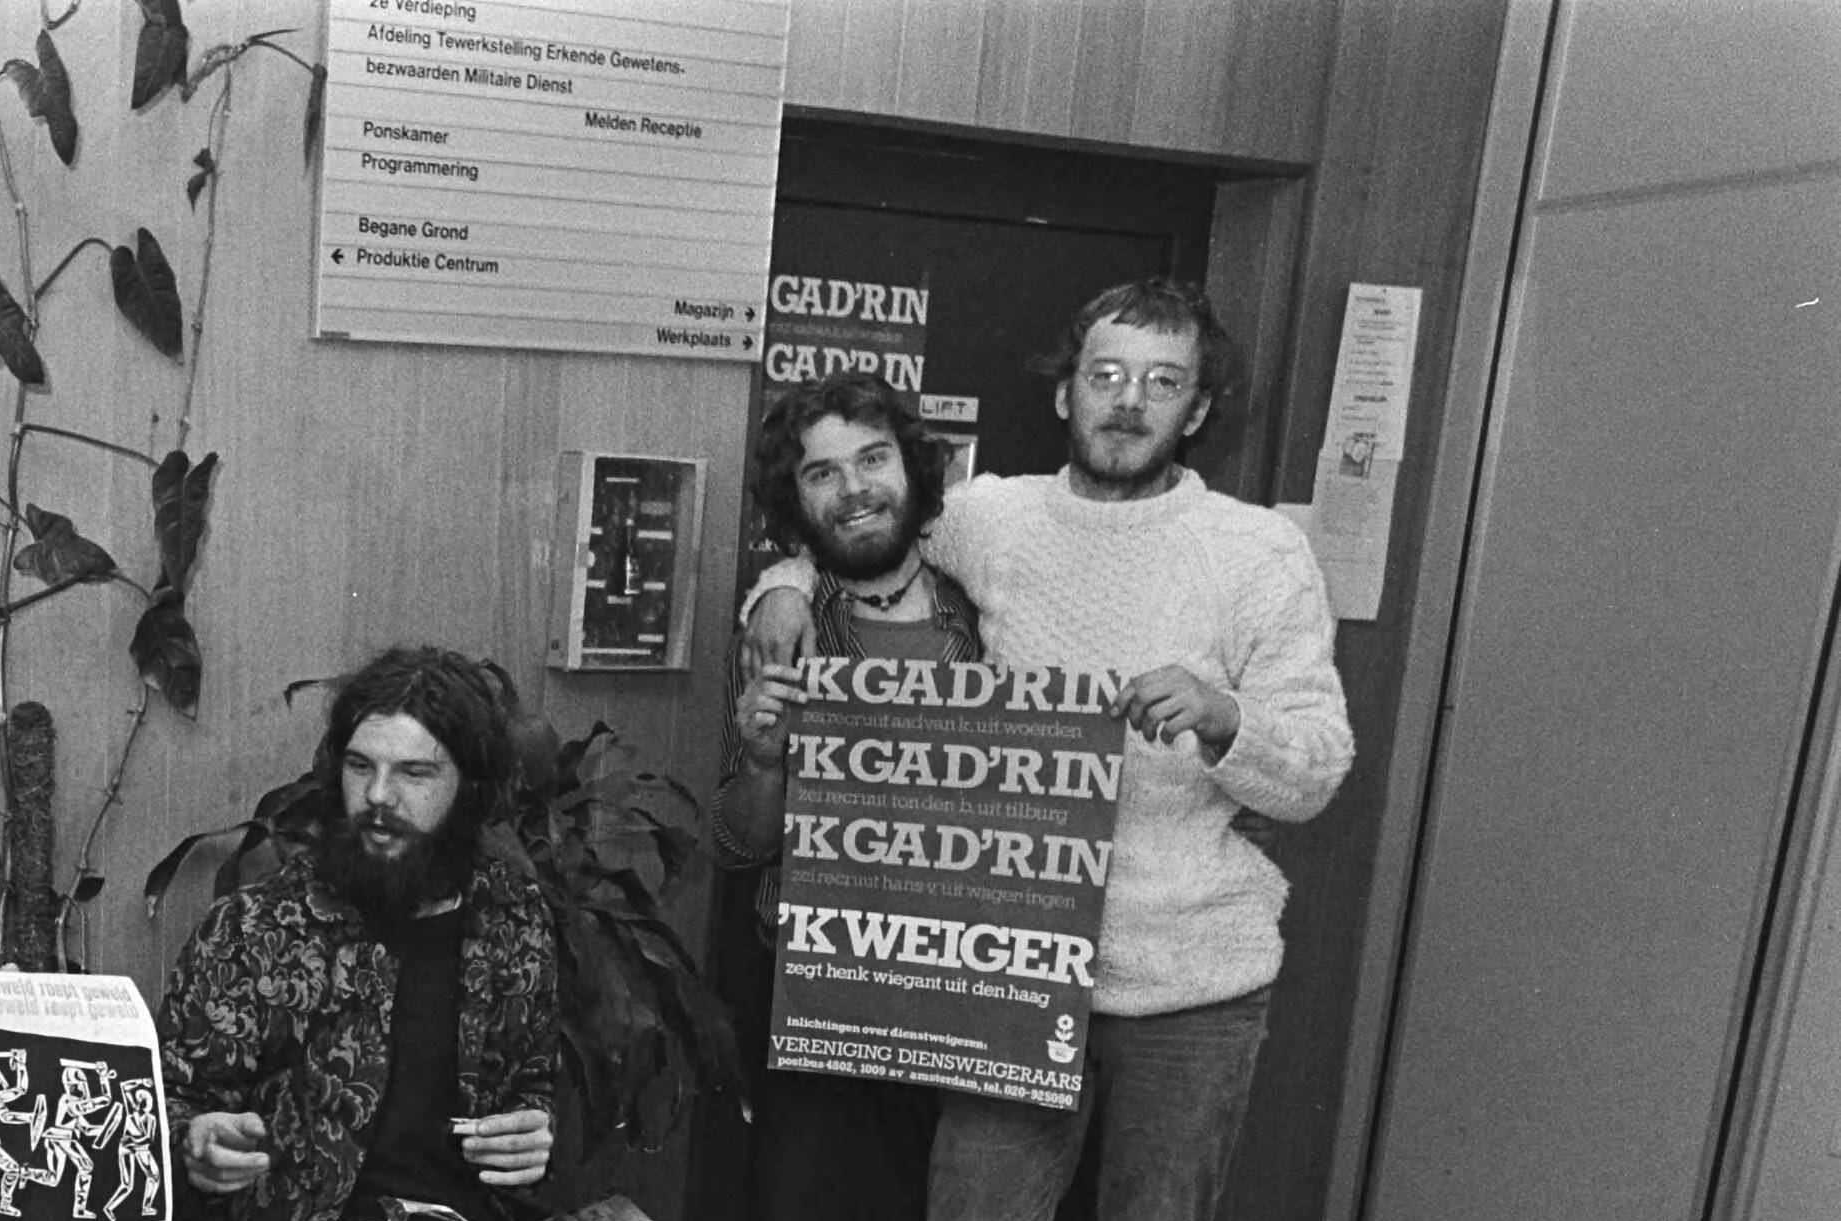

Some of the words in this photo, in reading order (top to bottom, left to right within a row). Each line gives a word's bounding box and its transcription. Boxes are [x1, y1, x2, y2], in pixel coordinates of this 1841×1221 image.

[396, 0, 476, 22] Verdieping
[367, 24, 431, 49] Afdeling
[437, 30, 542, 61] Tewerkstelling
[546, 43, 606, 65] Erkende
[366, 57, 459, 82] bezwaarden
[464, 66, 522, 89] Militaire
[526, 73, 573, 94] Dienst
[363, 121, 449, 145] Ponskamer
[585, 111, 636, 132] Melden
[640, 117, 702, 139] Receptie
[361, 153, 479, 181] Programmering
[358, 217, 417, 239] Begane
[421, 222, 469, 241] Grond
[356, 249, 430, 269] Produktie
[435, 253, 499, 274] Centrum
[674, 301, 734, 320] Magazijn
[657, 328, 731, 348] Werkplaats
[1003, 720, 1083, 739] woerden
[1005, 802, 1068, 826] tilburg
[841, 908, 1095, 987] WEIGER
[785, 962, 823, 979] zegt
[826, 963, 870, 982] henk
[872, 969, 943, 991] wiegant
[945, 977, 968, 994] uit
[972, 980, 1006, 999] den
[1008, 983, 1051, 1009] haag
[787, 1016, 860, 1034] inlichtingen
[862, 1025, 889, 1037] over
[771, 1035, 893, 1061] VERENIGING
[897, 1048, 1083, 1092] DIENSWEIGERAARS
[777, 1056, 824, 1069] postbus
